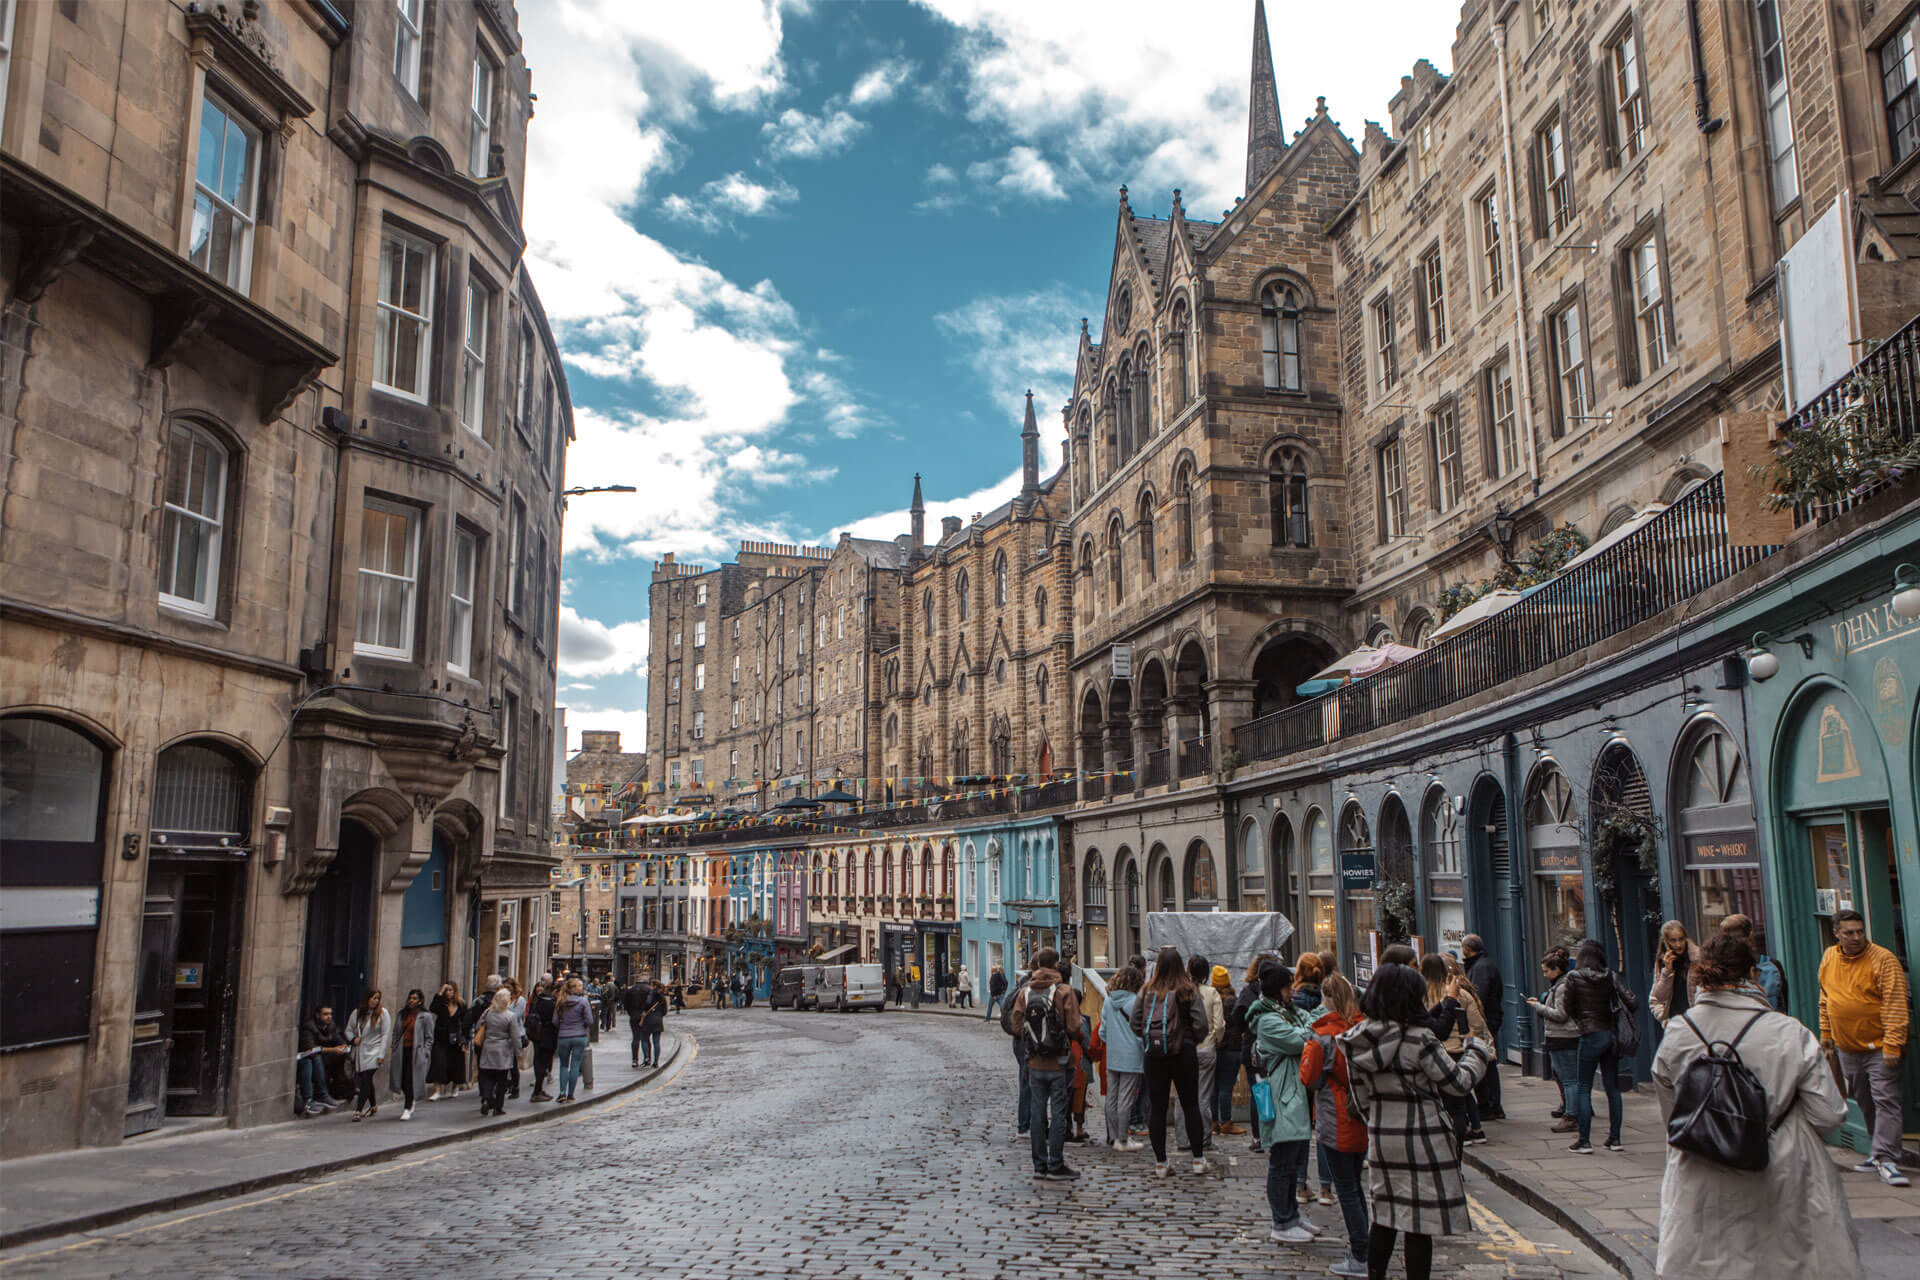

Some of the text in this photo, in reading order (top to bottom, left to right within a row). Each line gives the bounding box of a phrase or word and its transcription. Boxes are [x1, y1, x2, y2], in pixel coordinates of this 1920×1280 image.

[1832, 607, 1880, 663] JOHN
[1697, 844, 1714, 857] WINE
[1720, 843, 1747, 857] WHISKY
[1343, 869, 1375, 877] HOWIES
